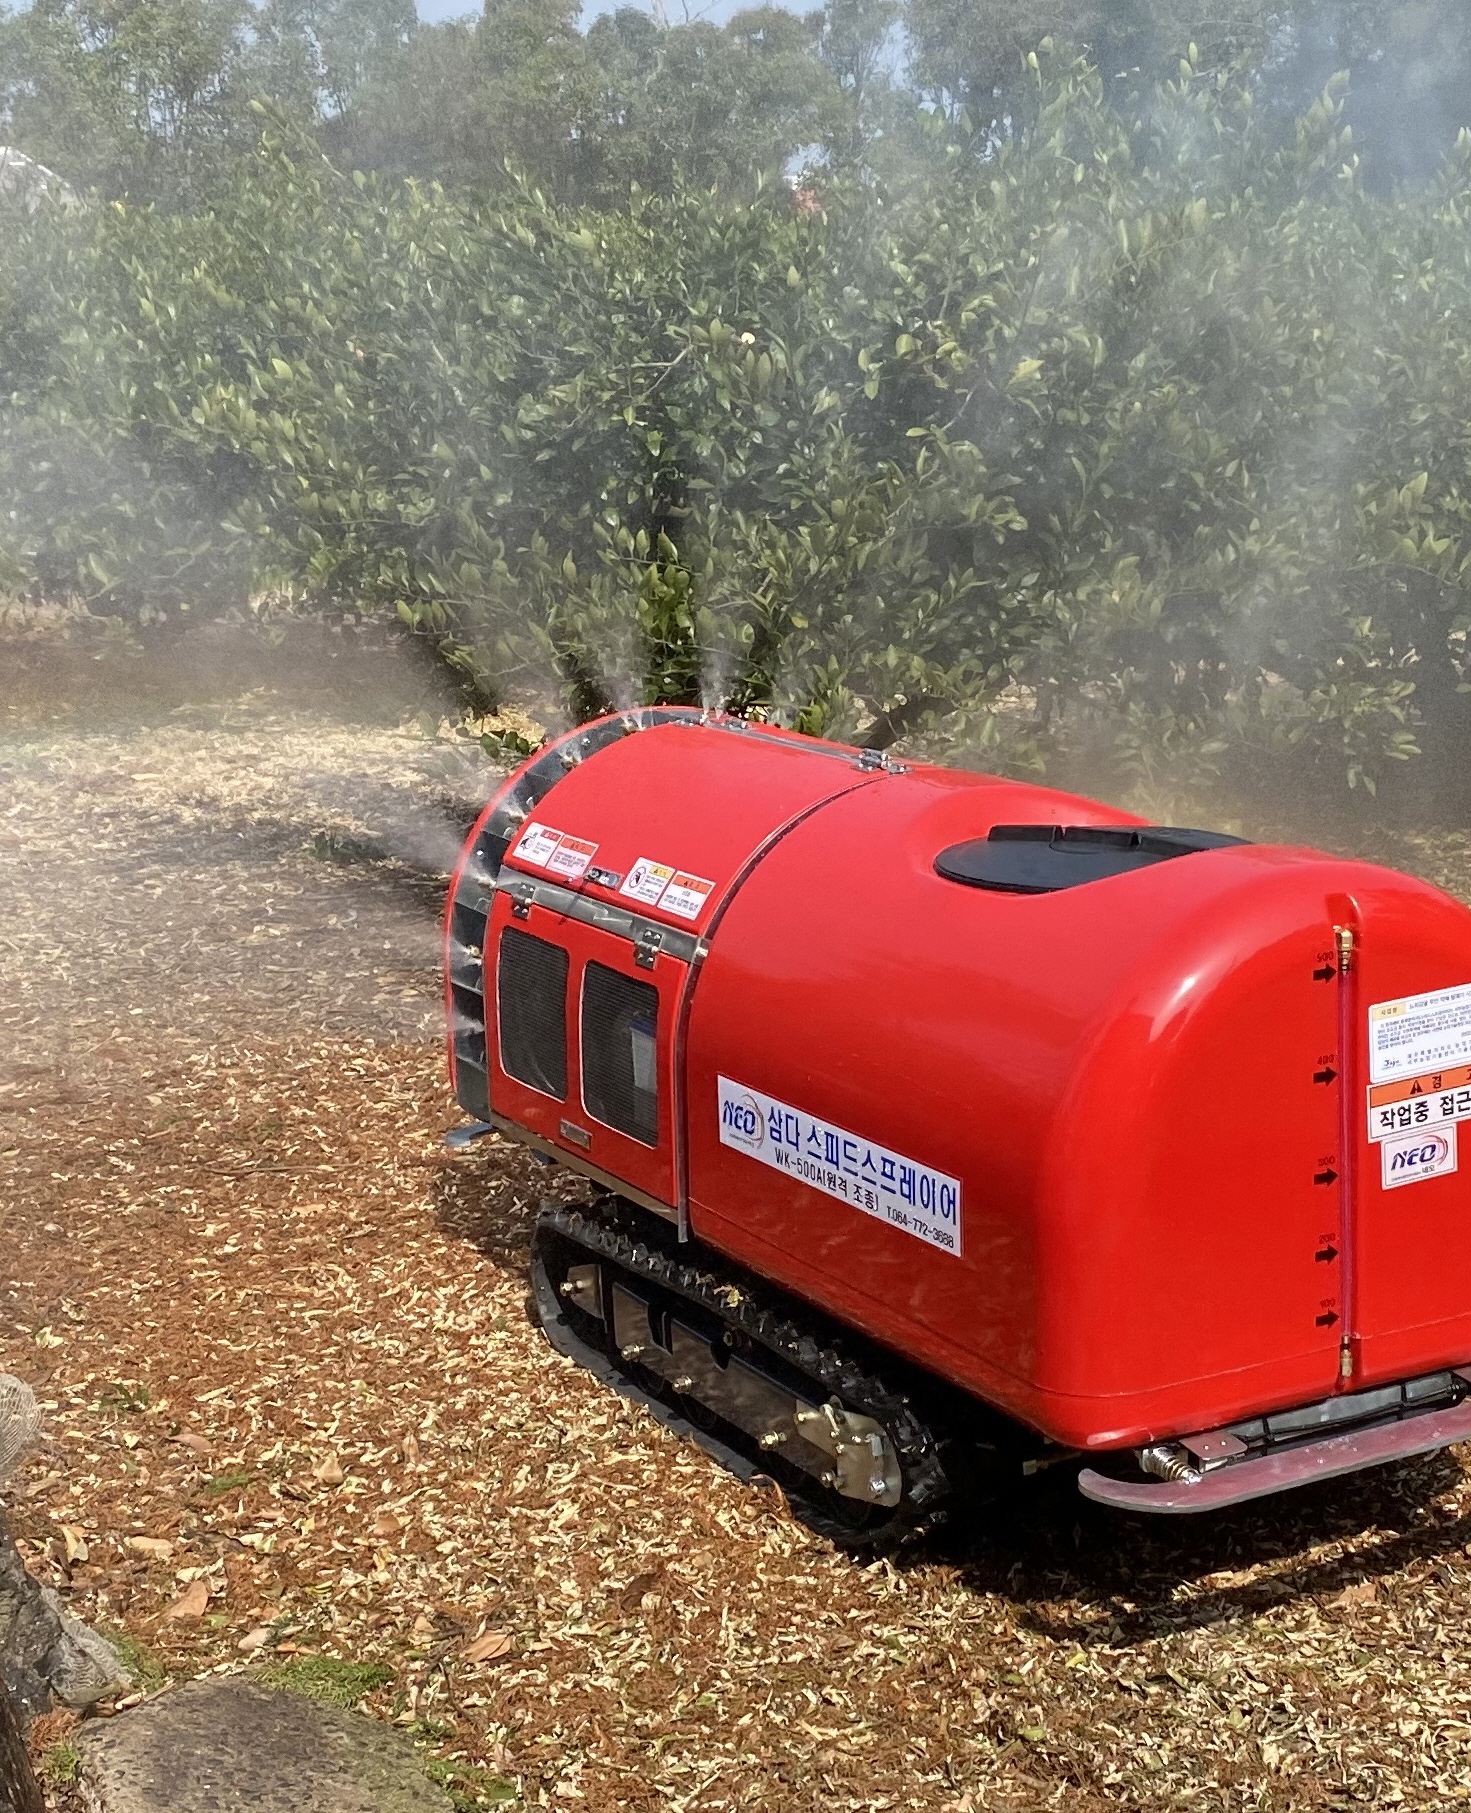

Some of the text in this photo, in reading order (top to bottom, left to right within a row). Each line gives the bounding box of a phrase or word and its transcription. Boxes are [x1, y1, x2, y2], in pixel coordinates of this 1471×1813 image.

[1316, 951, 1334, 963] 500
[1316, 1053, 1335, 1066] 400
[1432, 1074, 1442, 1089] 경
[722, 1100, 756, 1135] NEO
[1380, 1100, 1430, 1130] 작업중
[768, 1106, 957, 1226] 삼다 스피드스프레이어
[1391, 1144, 1437, 1171] NEO
[775, 1147, 879, 1212] WK-500A(원격 조종)
[1319, 1232, 1336, 1245] 200
